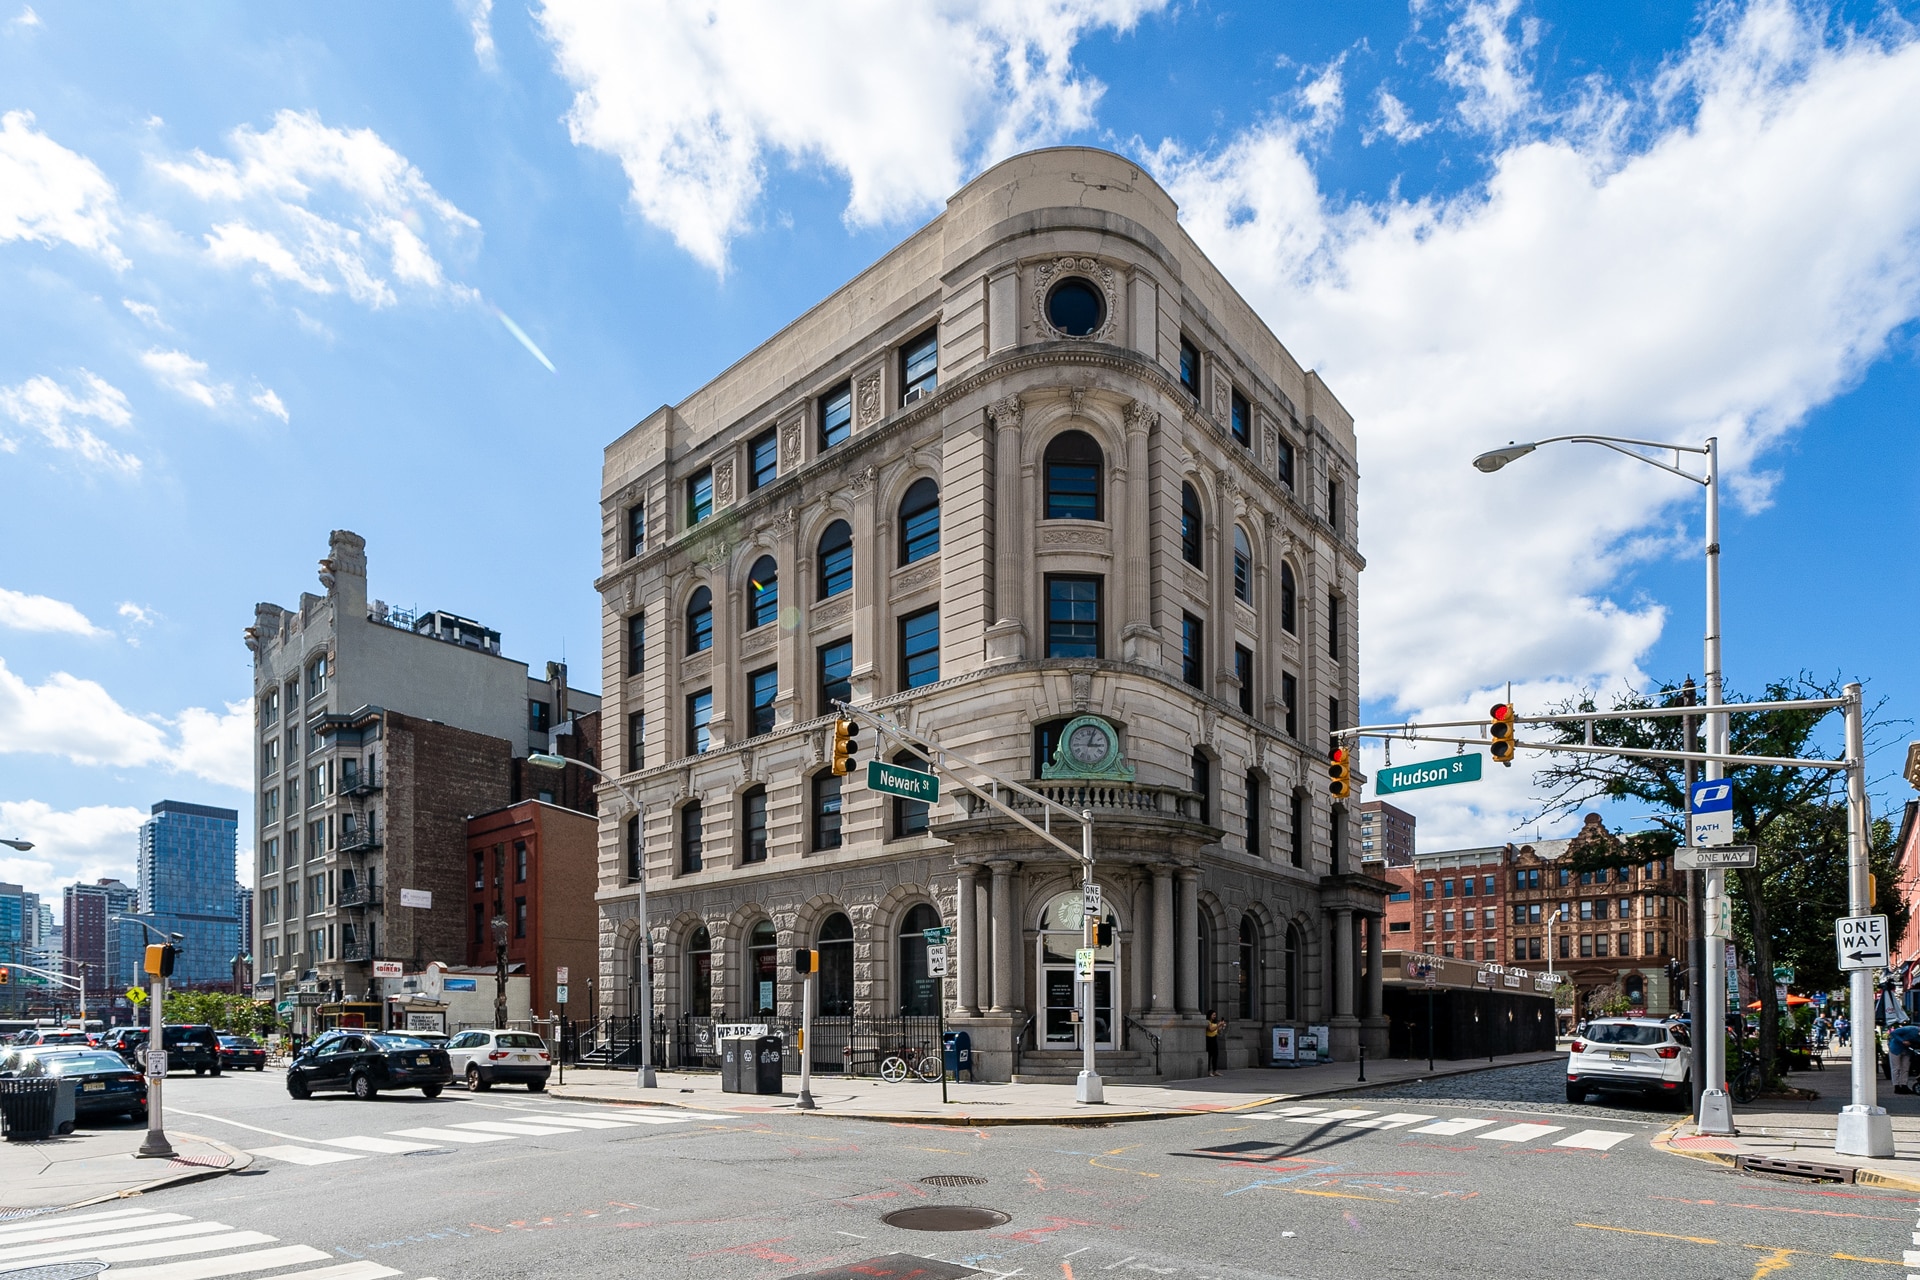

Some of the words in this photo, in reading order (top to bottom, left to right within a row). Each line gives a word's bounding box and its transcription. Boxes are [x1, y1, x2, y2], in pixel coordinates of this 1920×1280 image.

[1392, 767, 1448, 788] Hudson
[1452, 762, 1463, 773] St
[880, 769, 920, 793] Newark
[922, 779, 929, 791] St
[1695, 823, 1719, 832] PATH
[1697, 853, 1718, 862] ONE
[1722, 852, 1745, 861] WAY
[1085, 886, 1099, 895] ONE
[1085, 895, 1099, 904] WAY
[1843, 920, 1881, 934] ONE
[1843, 934, 1882, 949] WAY
[931, 947, 943, 956] ONE
[1078, 952, 1092, 960] ONE
[379, 965, 398, 973] DINER
[1078, 961, 1092, 969] WAY
[717, 1026, 732, 1038] WE
[734, 1026, 753, 1036] ARE
